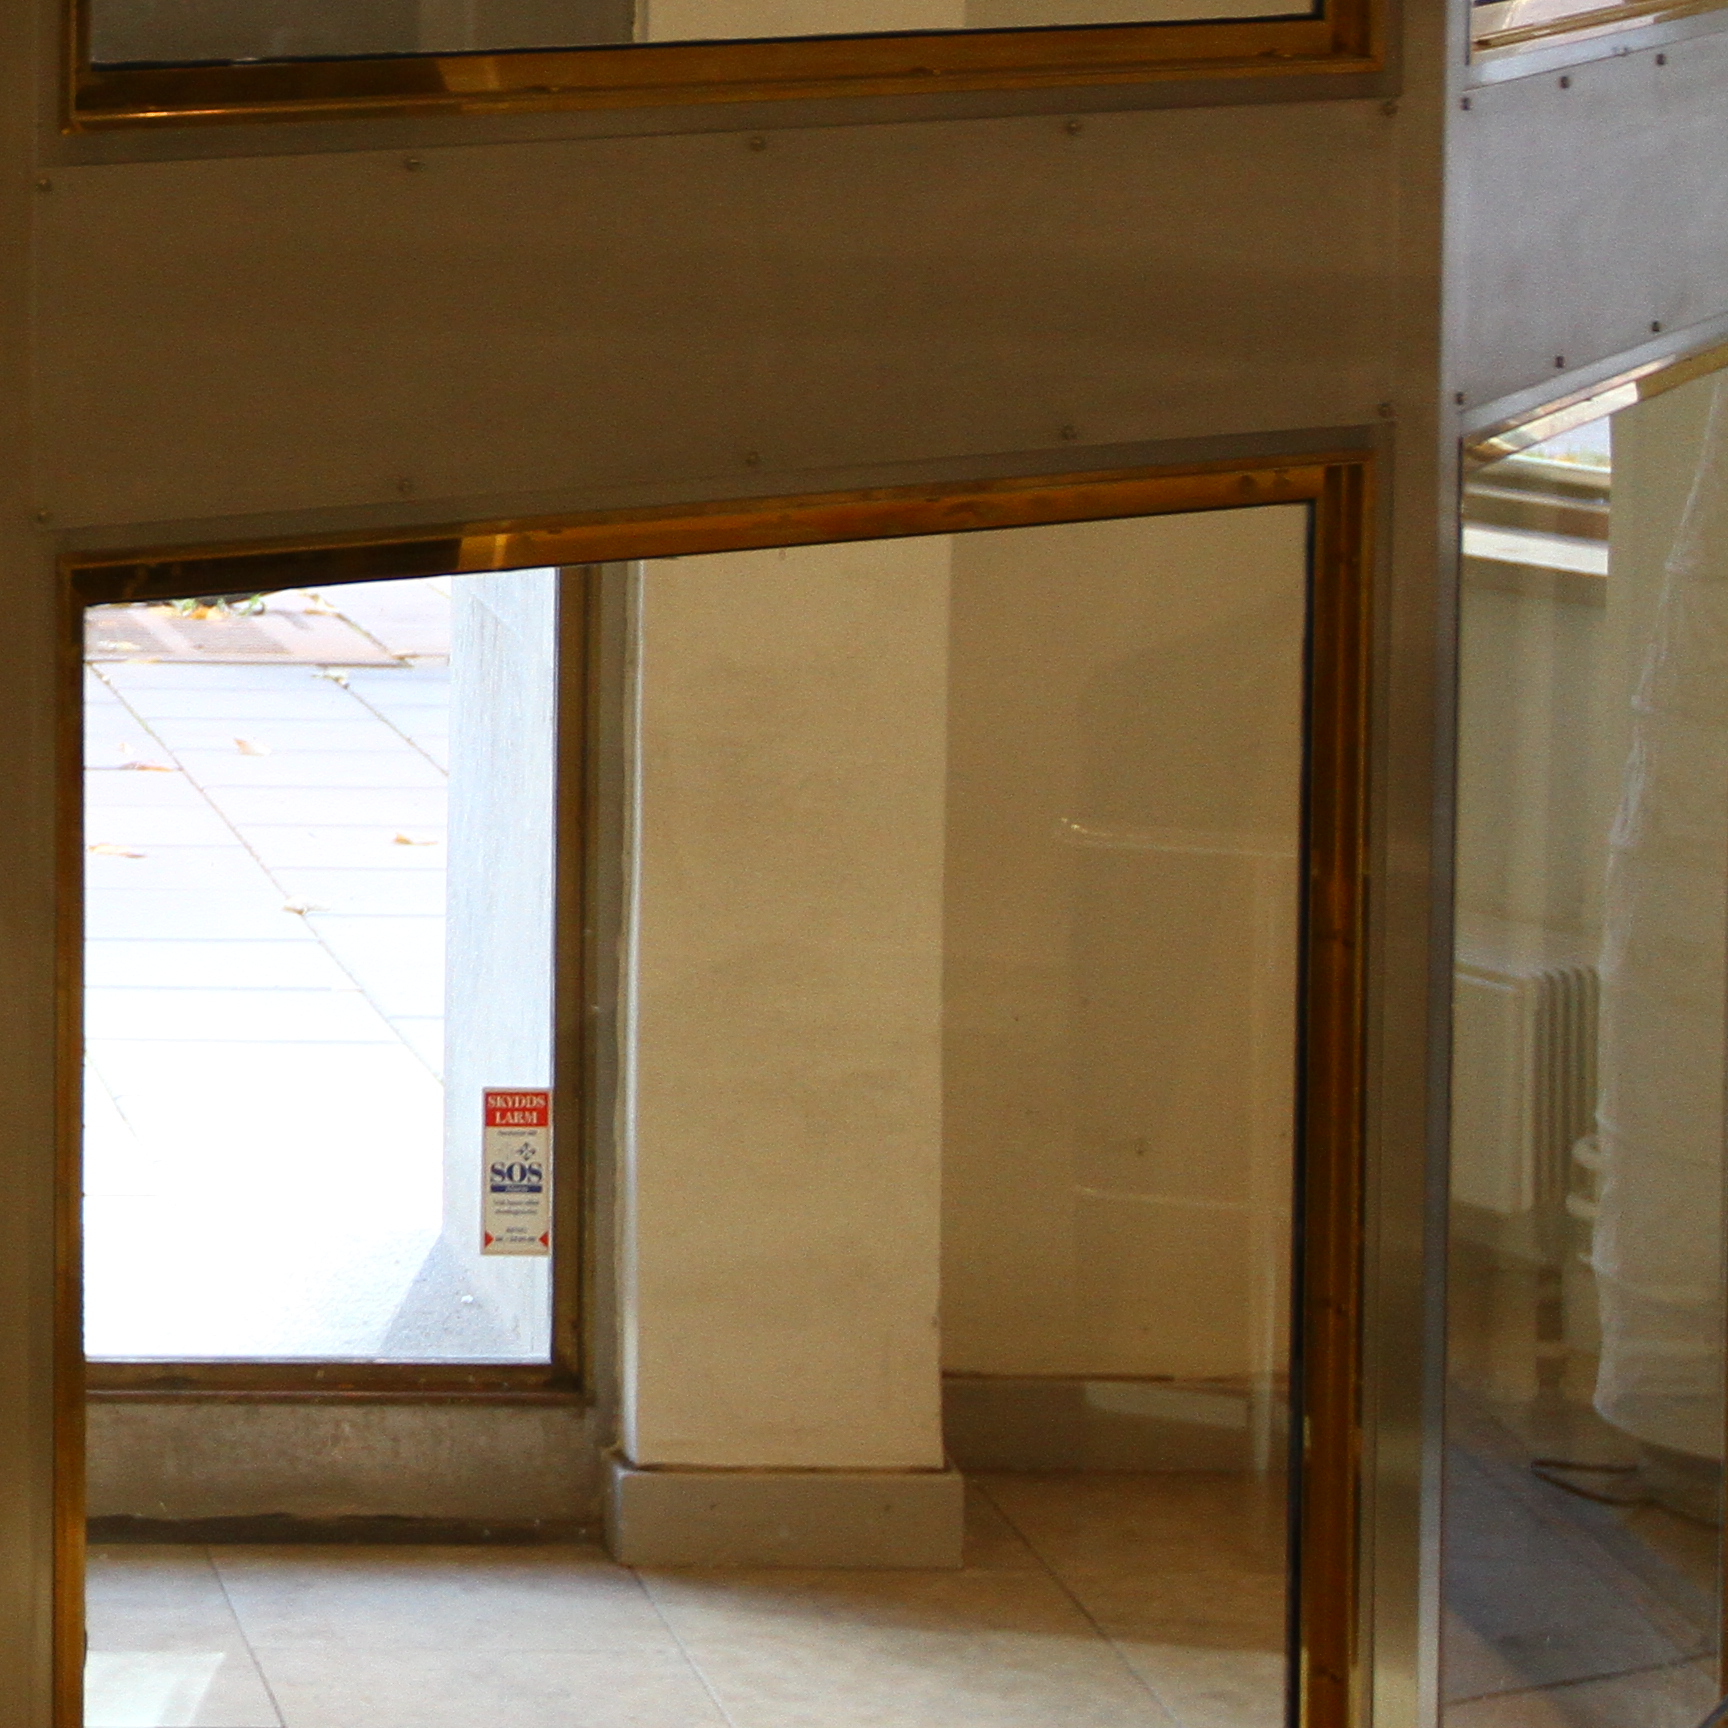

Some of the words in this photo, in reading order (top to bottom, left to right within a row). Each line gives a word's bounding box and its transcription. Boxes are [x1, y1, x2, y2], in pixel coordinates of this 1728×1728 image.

[488, 1095, 547, 1108] SKYDDS
[495, 1111, 538, 1124] LARM
[490, 1161, 543, 1184] SOS
